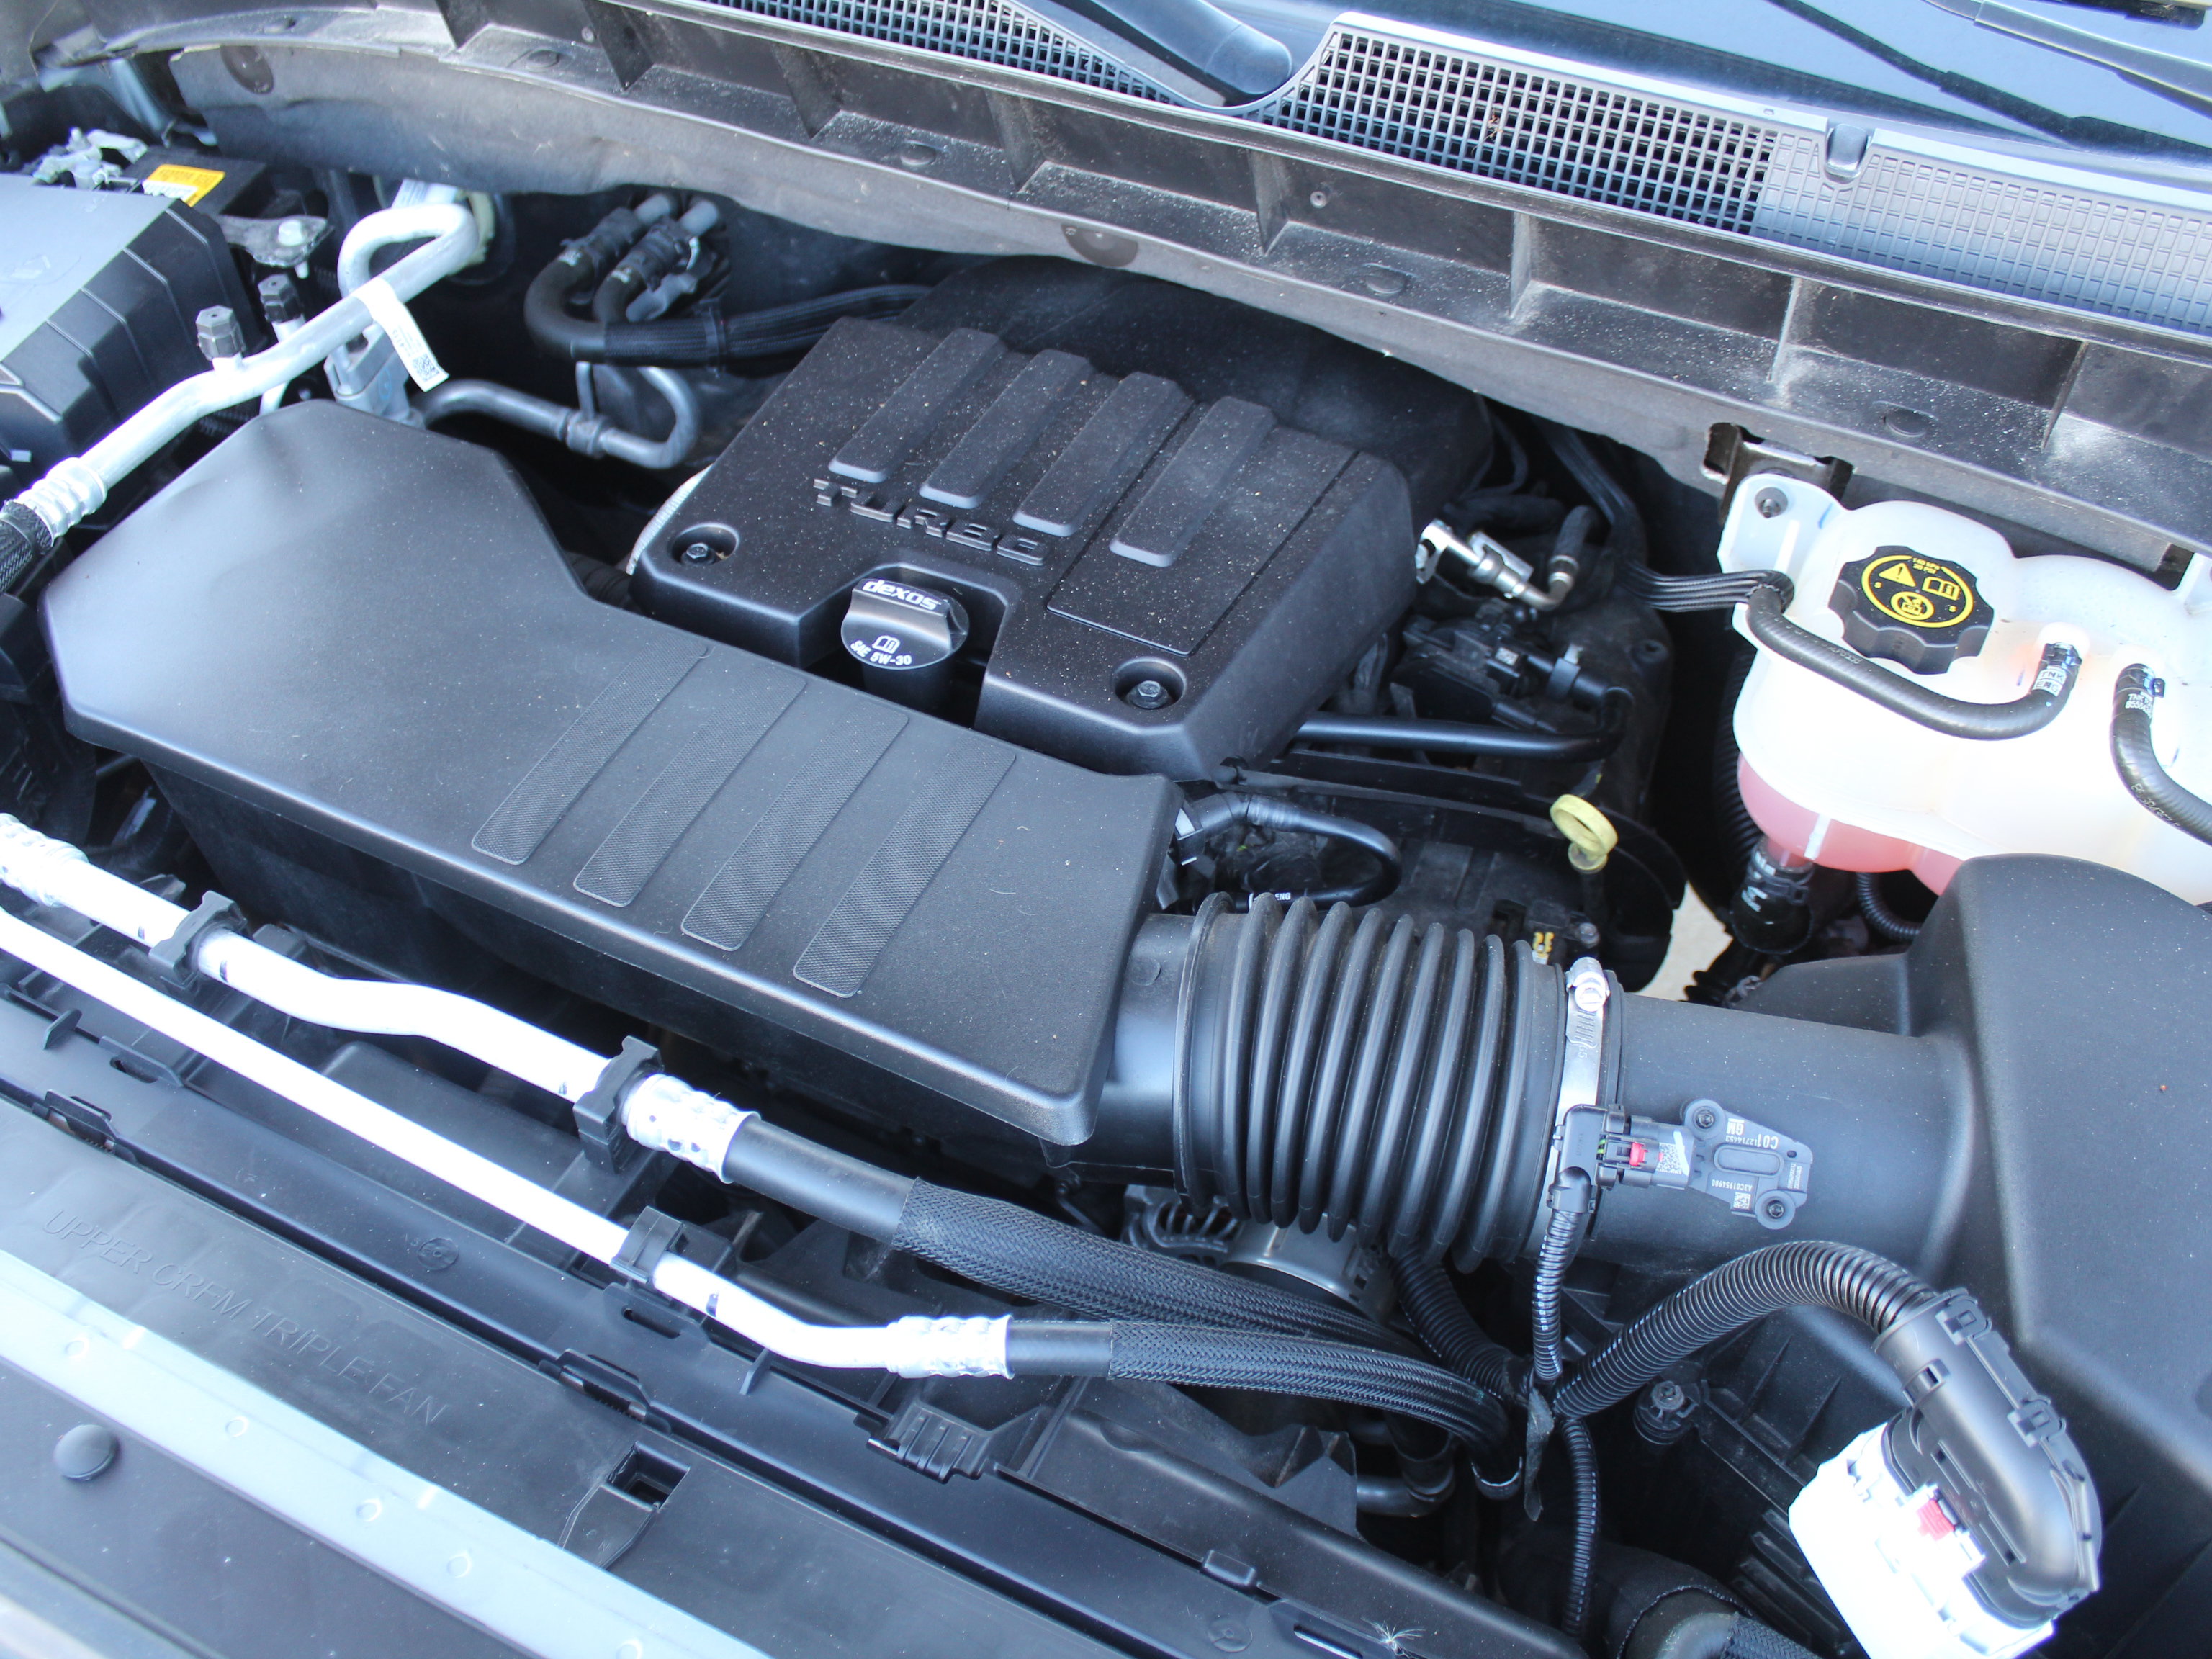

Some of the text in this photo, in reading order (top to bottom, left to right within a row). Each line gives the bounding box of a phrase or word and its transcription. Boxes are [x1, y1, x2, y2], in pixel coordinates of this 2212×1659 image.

[814, 478, 1048, 566] TURBO
[862, 579, 940, 611] dexos
[850, 640, 912, 666] SAE 5W-30
[2036, 681, 2059, 693] ENG
[2041, 670, 2064, 682] TNK
[1726, 1121, 1744, 1136] GM
[42, 1210, 449, 1427] UPPER CRFM TRIPLE FAN
